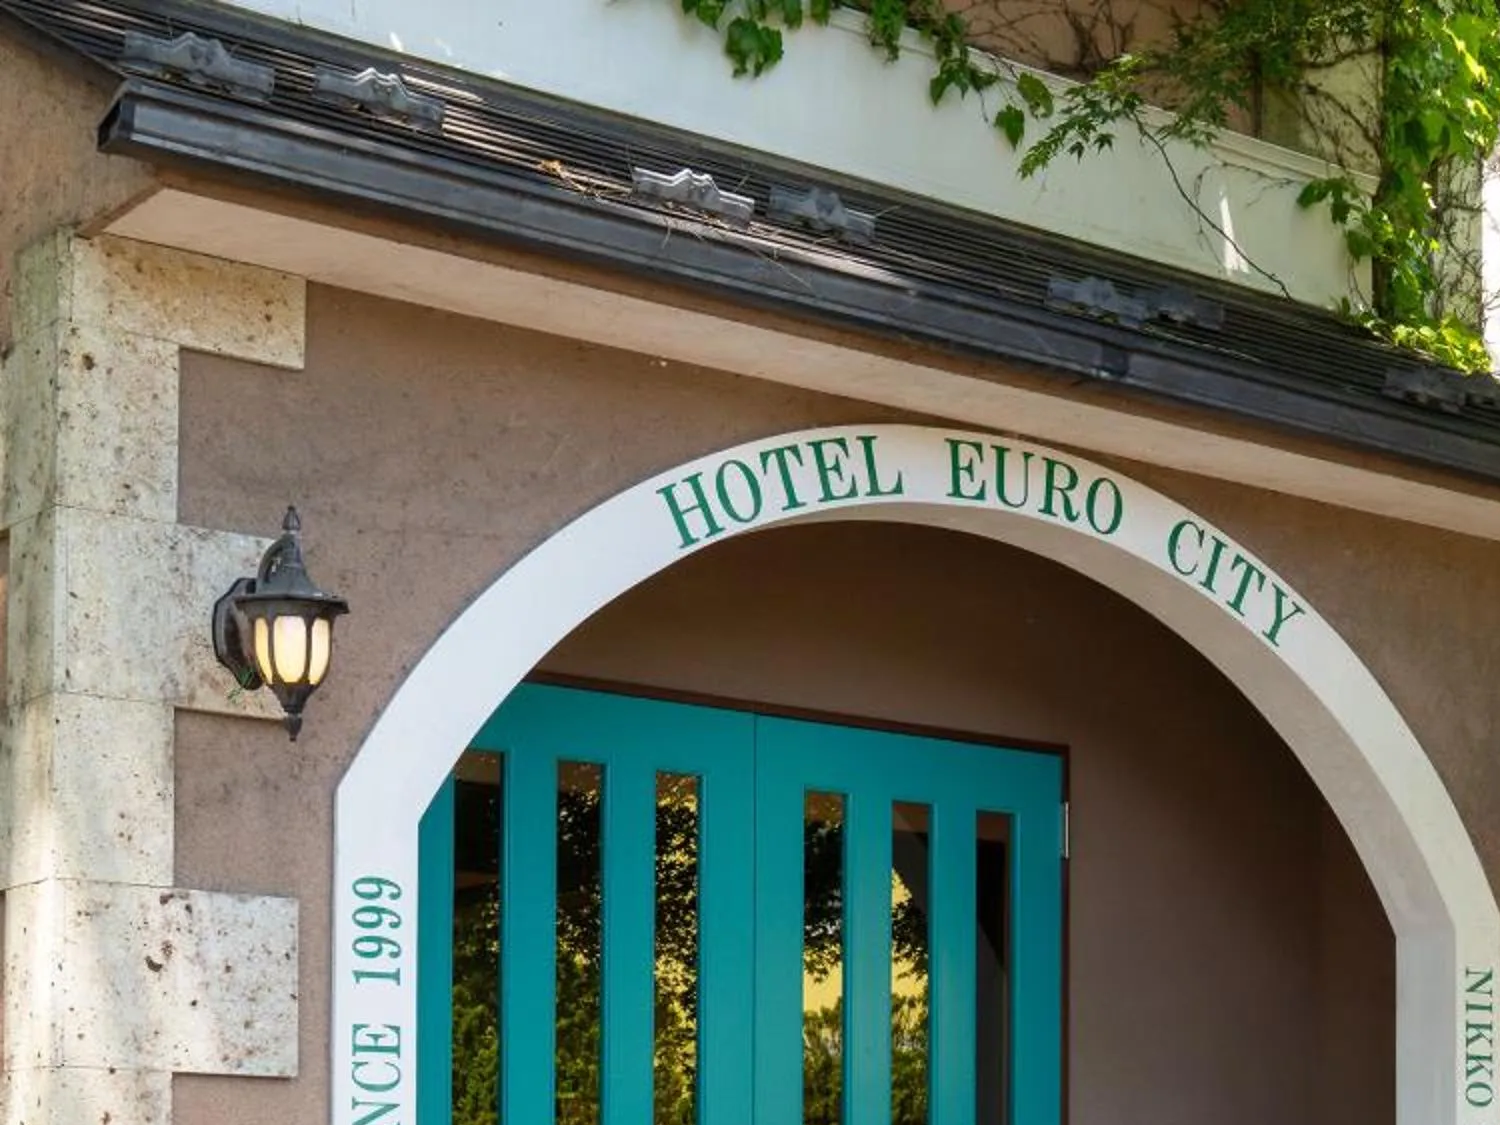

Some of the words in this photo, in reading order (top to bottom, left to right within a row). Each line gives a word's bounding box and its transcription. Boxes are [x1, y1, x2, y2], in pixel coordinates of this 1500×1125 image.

[656, 435, 903, 550] HOTEL
[945, 438, 1124, 535] EURO
[1167, 519, 1306, 648] CITY
[351, 875, 403, 986] 1999
[1465, 967, 1494, 1108] NIKKO
